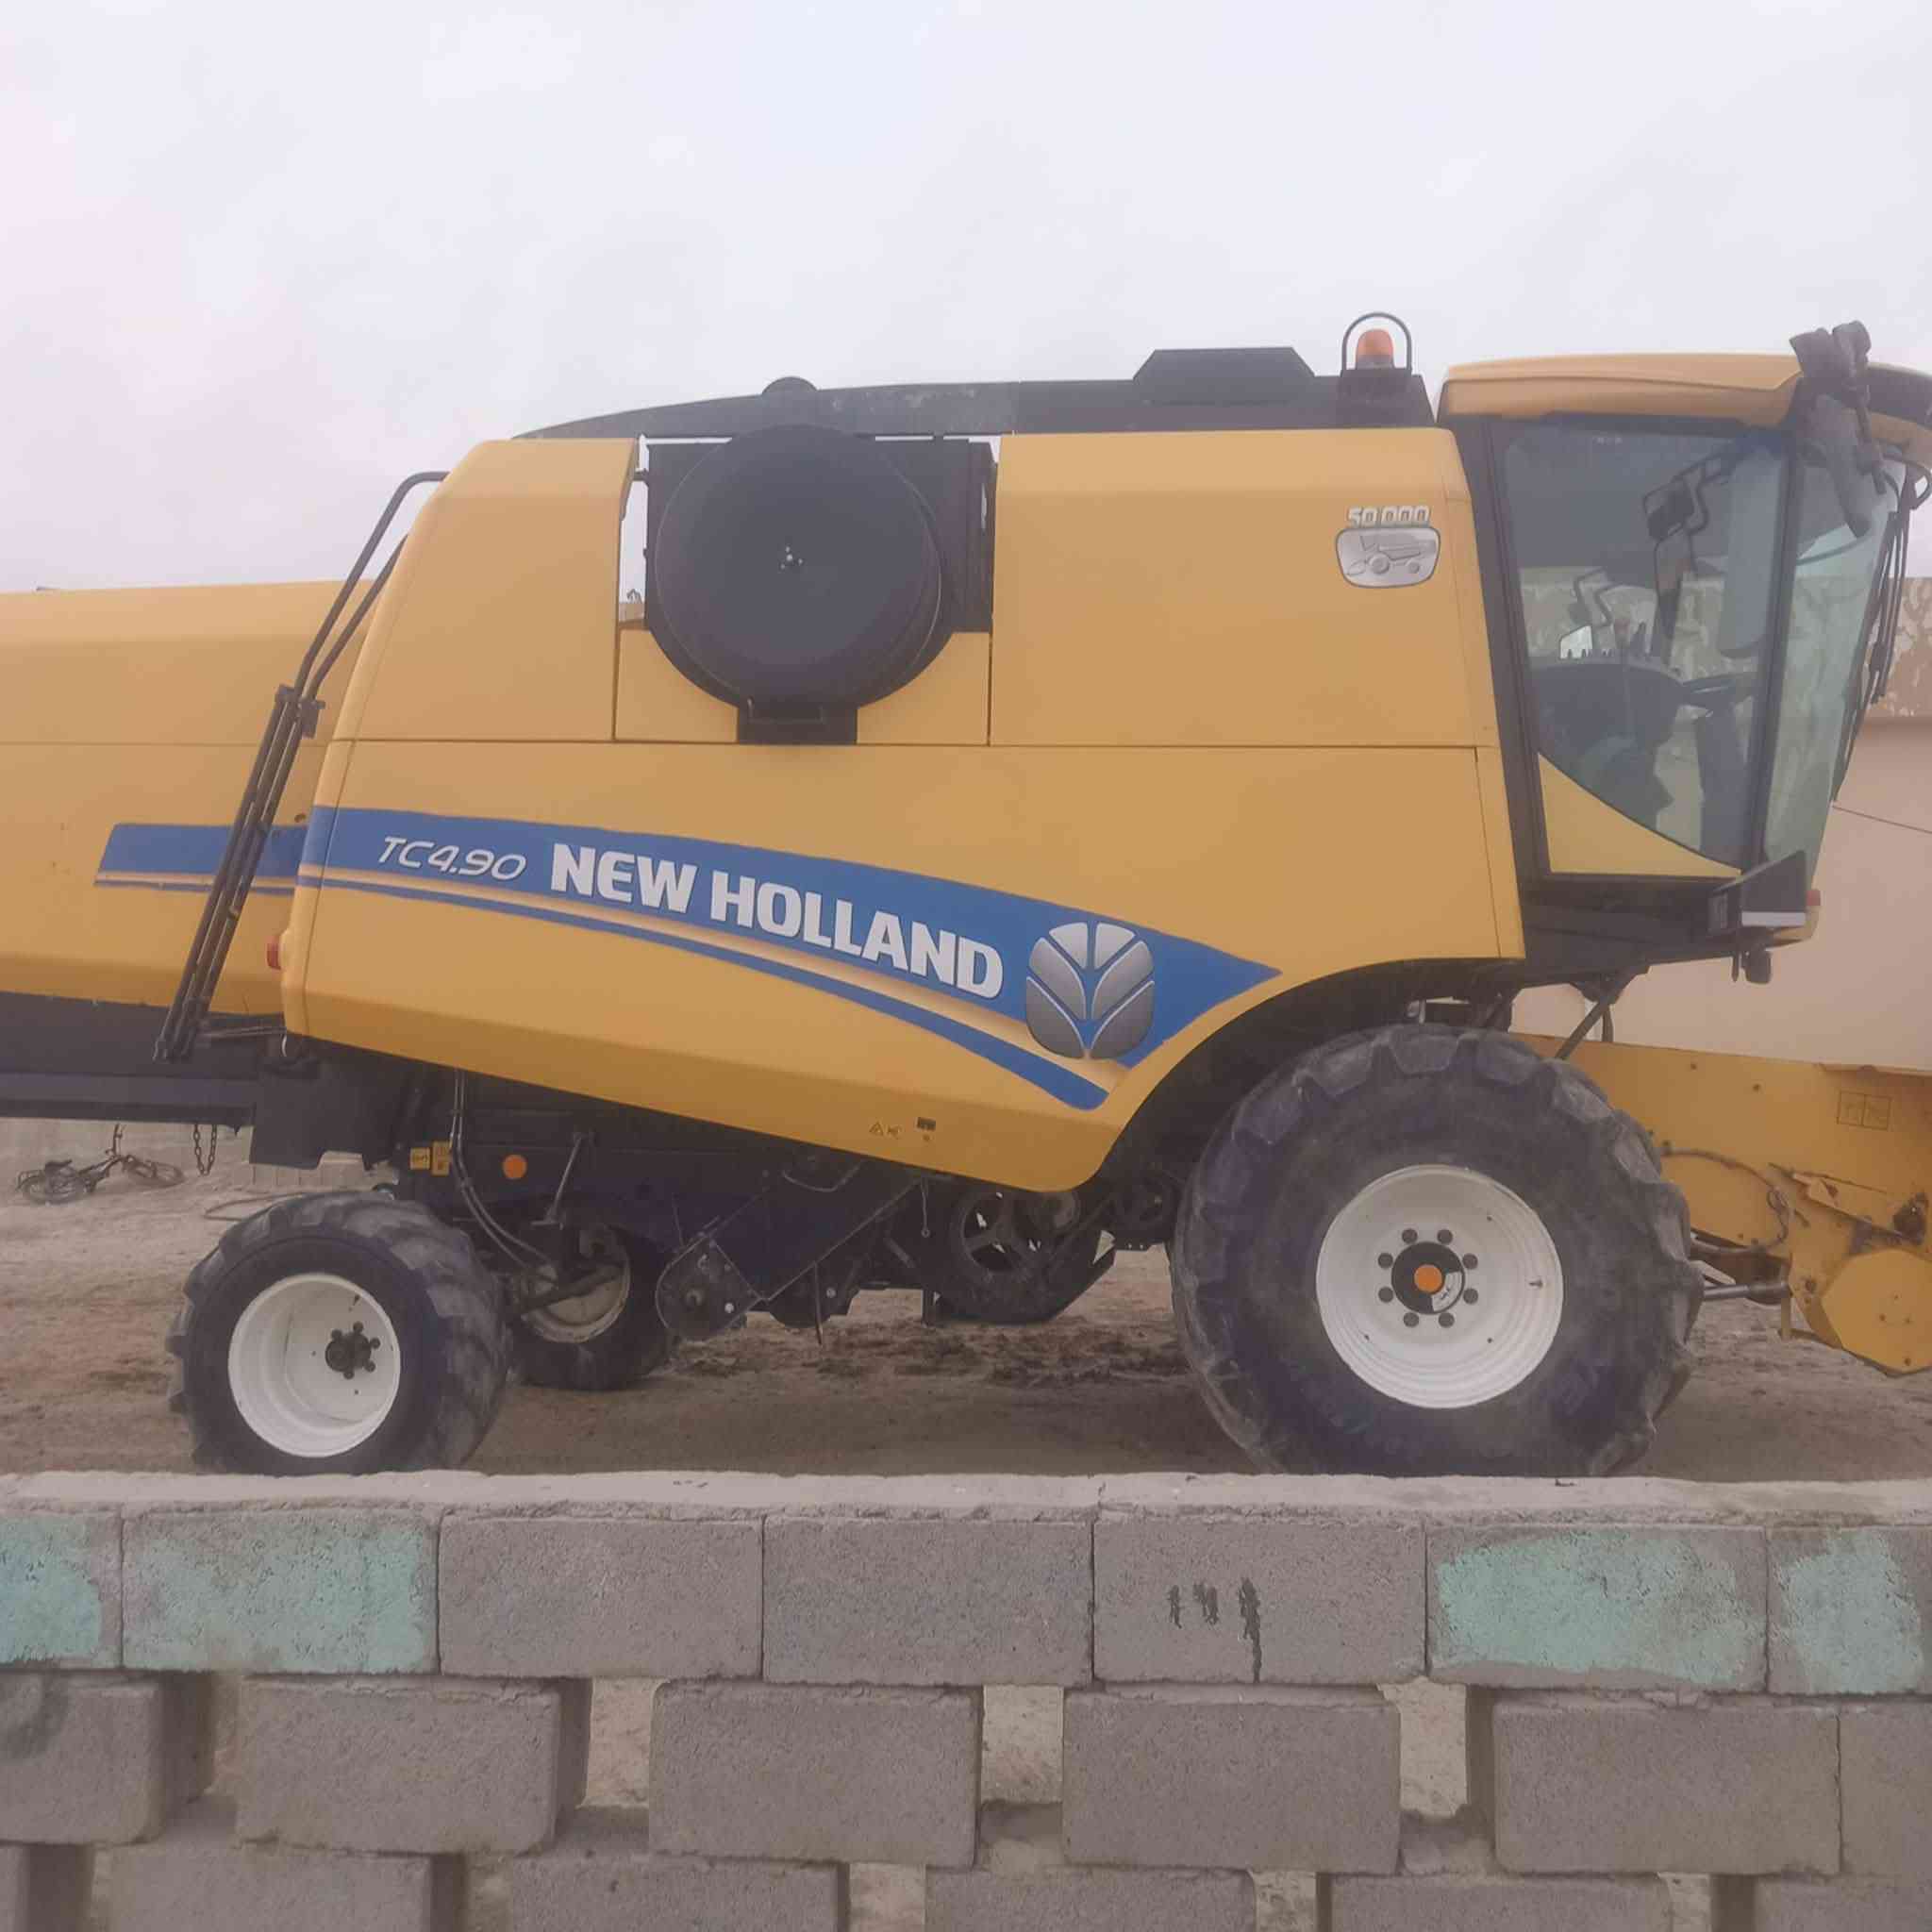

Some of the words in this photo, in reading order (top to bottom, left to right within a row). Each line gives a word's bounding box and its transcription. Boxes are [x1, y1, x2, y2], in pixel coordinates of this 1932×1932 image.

[378, 836, 527, 880] TC4.90
[551, 843, 697, 913] NEW
[710, 871, 1004, 999] HOLLAND
